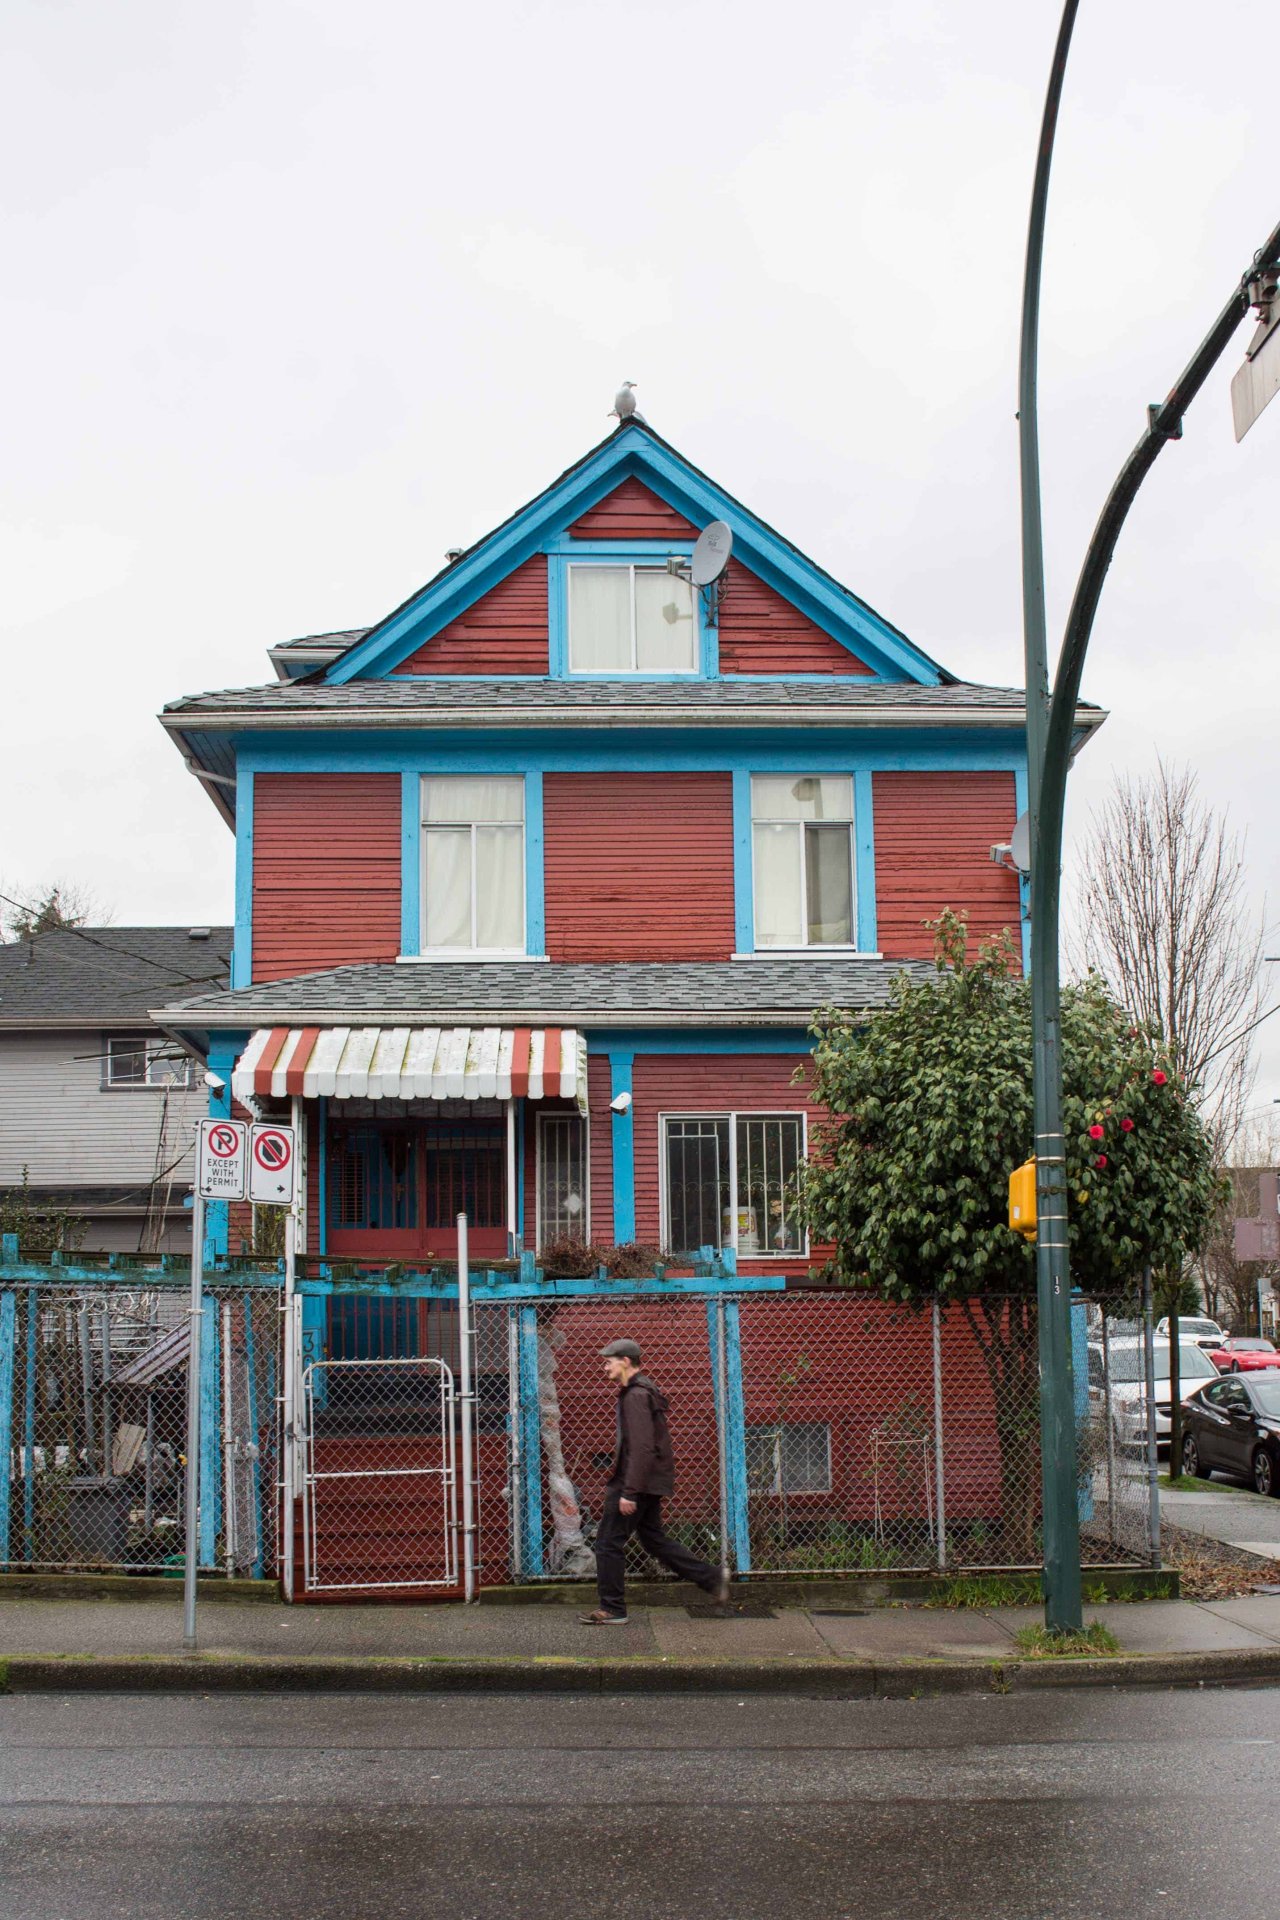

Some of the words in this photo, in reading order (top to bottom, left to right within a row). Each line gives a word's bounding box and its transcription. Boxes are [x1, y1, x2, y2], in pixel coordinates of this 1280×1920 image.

[207, 1158, 239, 1168] EXCEPT
[211, 1168, 234, 1177] WITH
[207, 1176, 239, 1187] PERMIT
